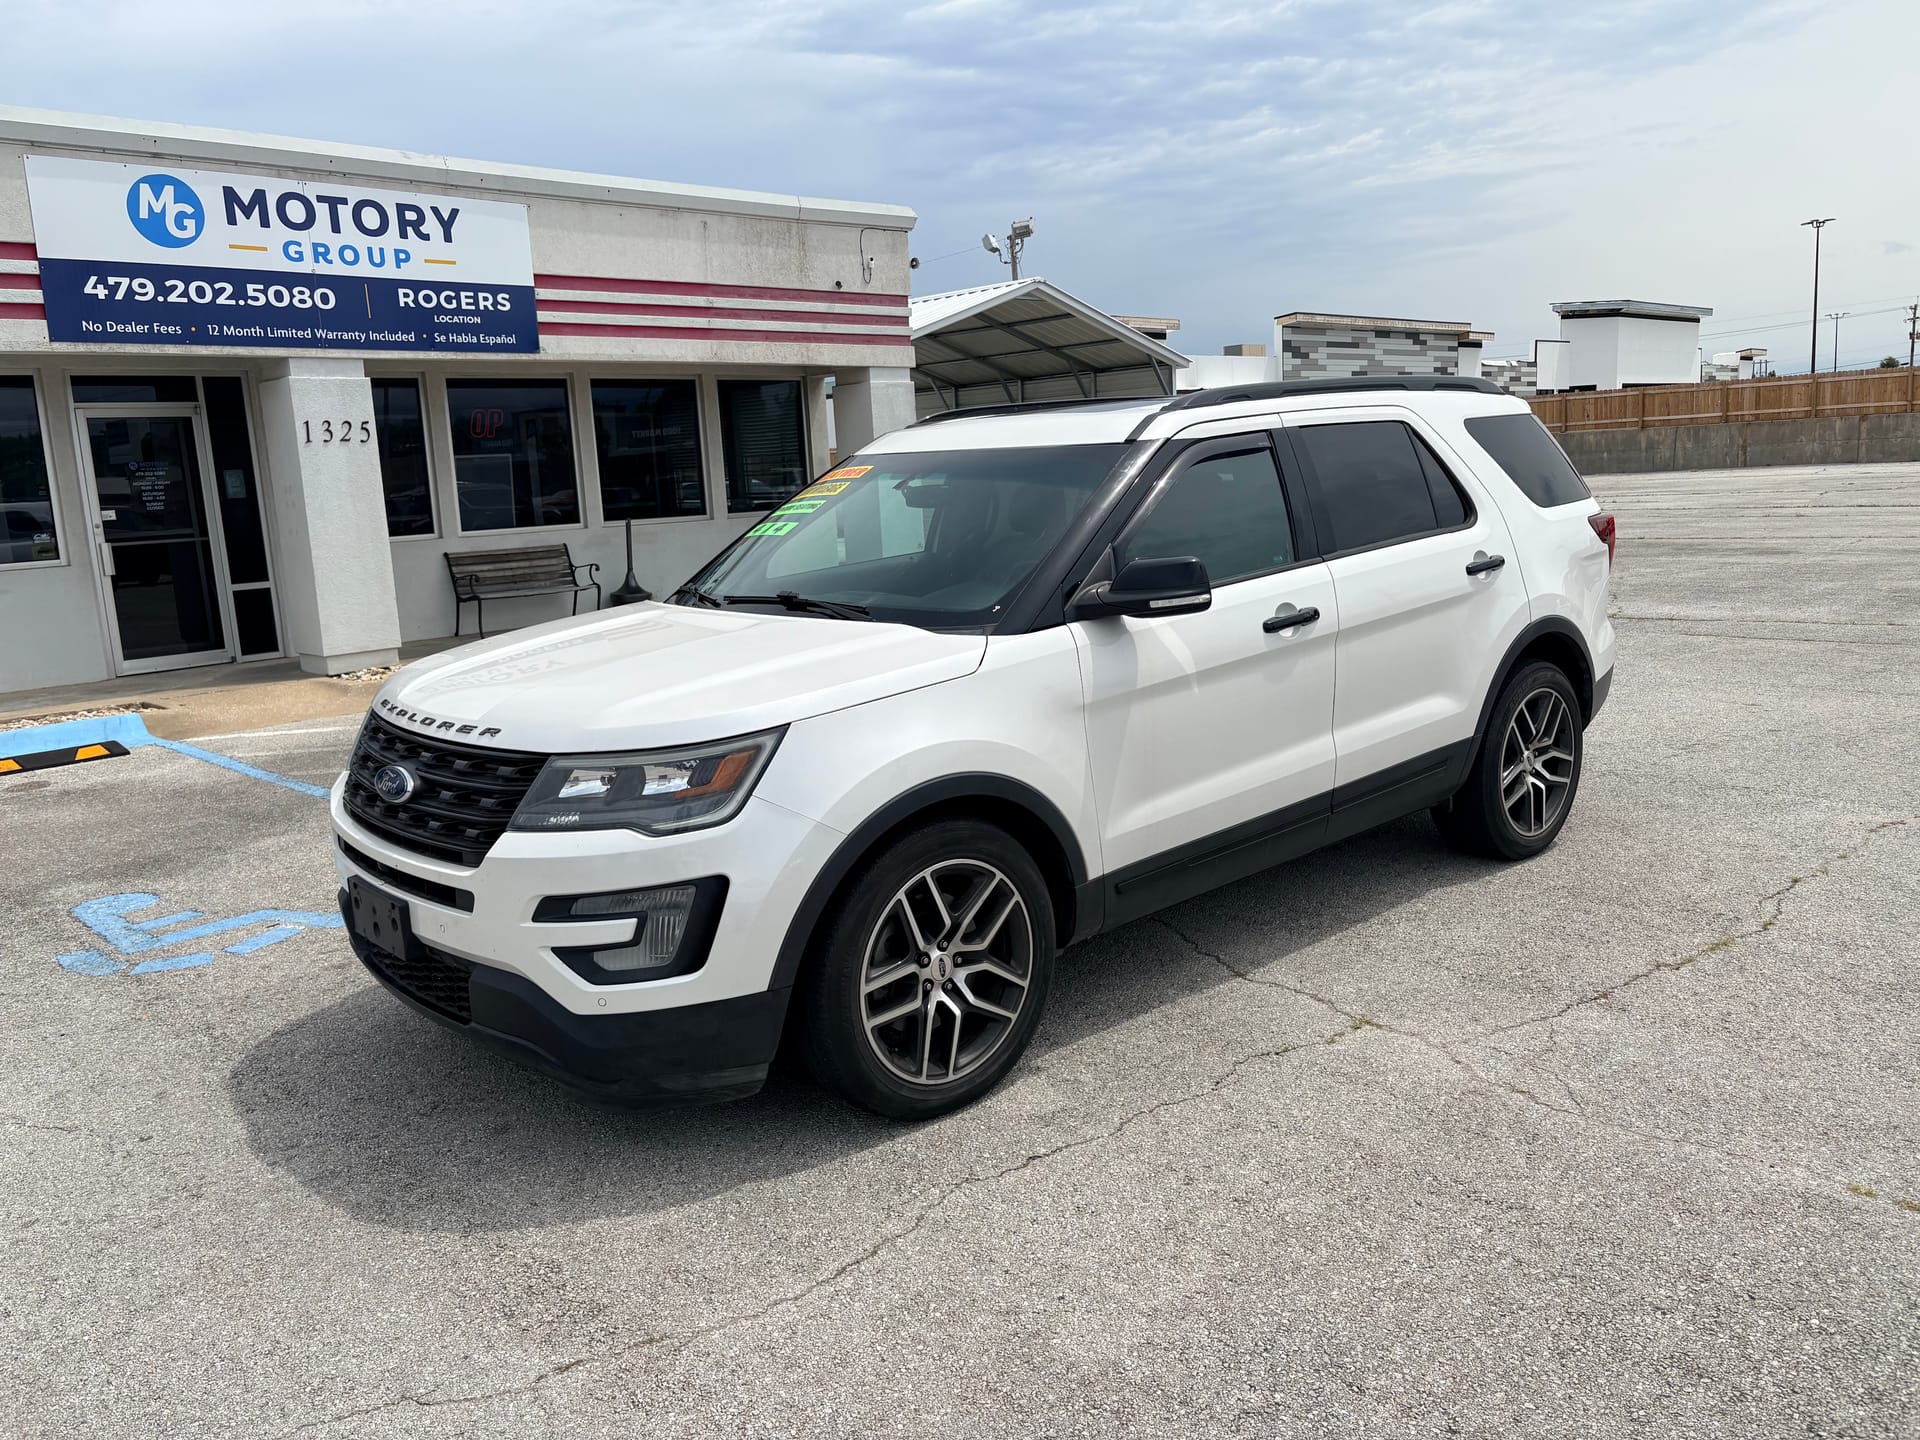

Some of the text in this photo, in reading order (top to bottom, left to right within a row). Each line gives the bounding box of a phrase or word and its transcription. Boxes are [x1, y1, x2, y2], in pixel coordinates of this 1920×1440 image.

[139, 182, 196, 239] MG
[222, 185, 460, 243] MOTORY
[282, 239, 412, 269] GROUP
[83, 275, 337, 310] 479.202.5080
[398, 287, 512, 311] ROGERS
[81, 320, 517, 346] No Dealer Fees 12 Month Limited Warranty Included Se Habla Español
[434, 314, 481, 325] LOCATION
[303, 420, 371, 443] 1325
[380, 698, 503, 738] EXPLORER
